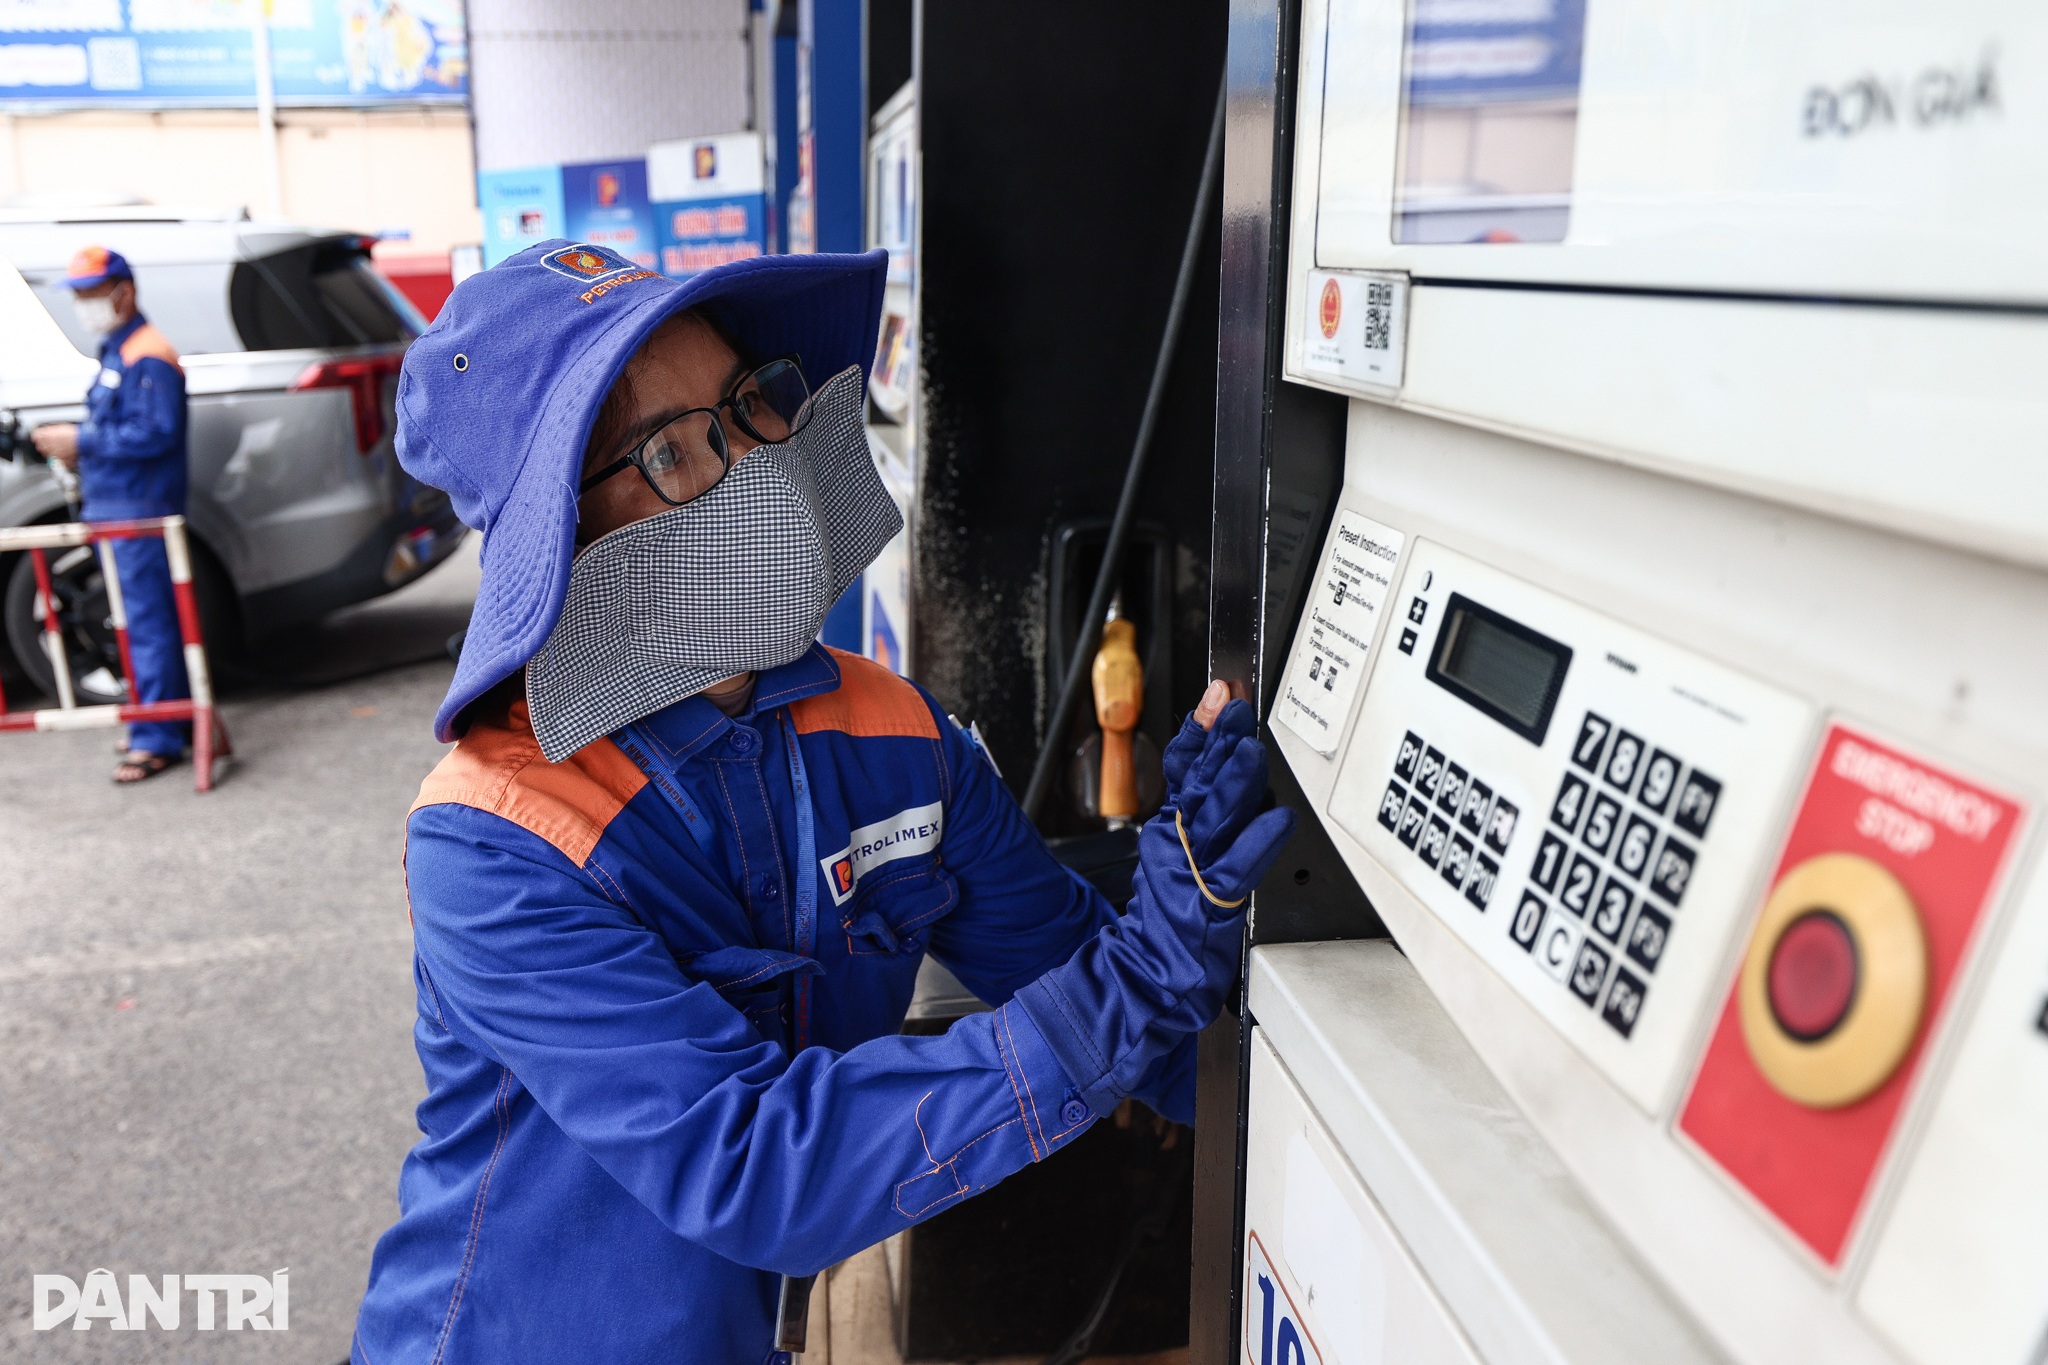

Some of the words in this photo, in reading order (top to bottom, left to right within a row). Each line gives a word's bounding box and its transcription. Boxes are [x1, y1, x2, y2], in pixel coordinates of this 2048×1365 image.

[1338, 525, 1360, 545] Preset
[1359, 535, 1396, 560] Instruction
[1312, 607, 1318, 620] 2
[1287, 686, 1293, 699] 3
[1398, 740, 1419, 773] P1
[1418, 755, 1441, 790] P2
[1440, 771, 1465, 807] P3
[1464, 788, 1488, 826] P4
[1578, 719, 1606, 762] 7
[1609, 738, 1639, 785] 8
[1643, 757, 1674, 807] 9
[1832, 738, 2001, 842] EMERGENCY
[1381, 789, 1402, 823] P6
[1401, 806, 1424, 839] P7
[1422, 823, 1446, 859] P8
[1445, 842, 1470, 880] P9
[1556, 781, 1581, 826] 4
[1587, 801, 1617, 848] 5
[1620, 823, 1649, 872] 6
[1855, 797, 1935, 857] STOP
[1539, 842, 1561, 884] 1
[1564, 863, 1592, 911] 2
[1597, 887, 1627, 935] 3
[1515, 899, 1540, 943] 0
[1547, 928, 1570, 966] C
